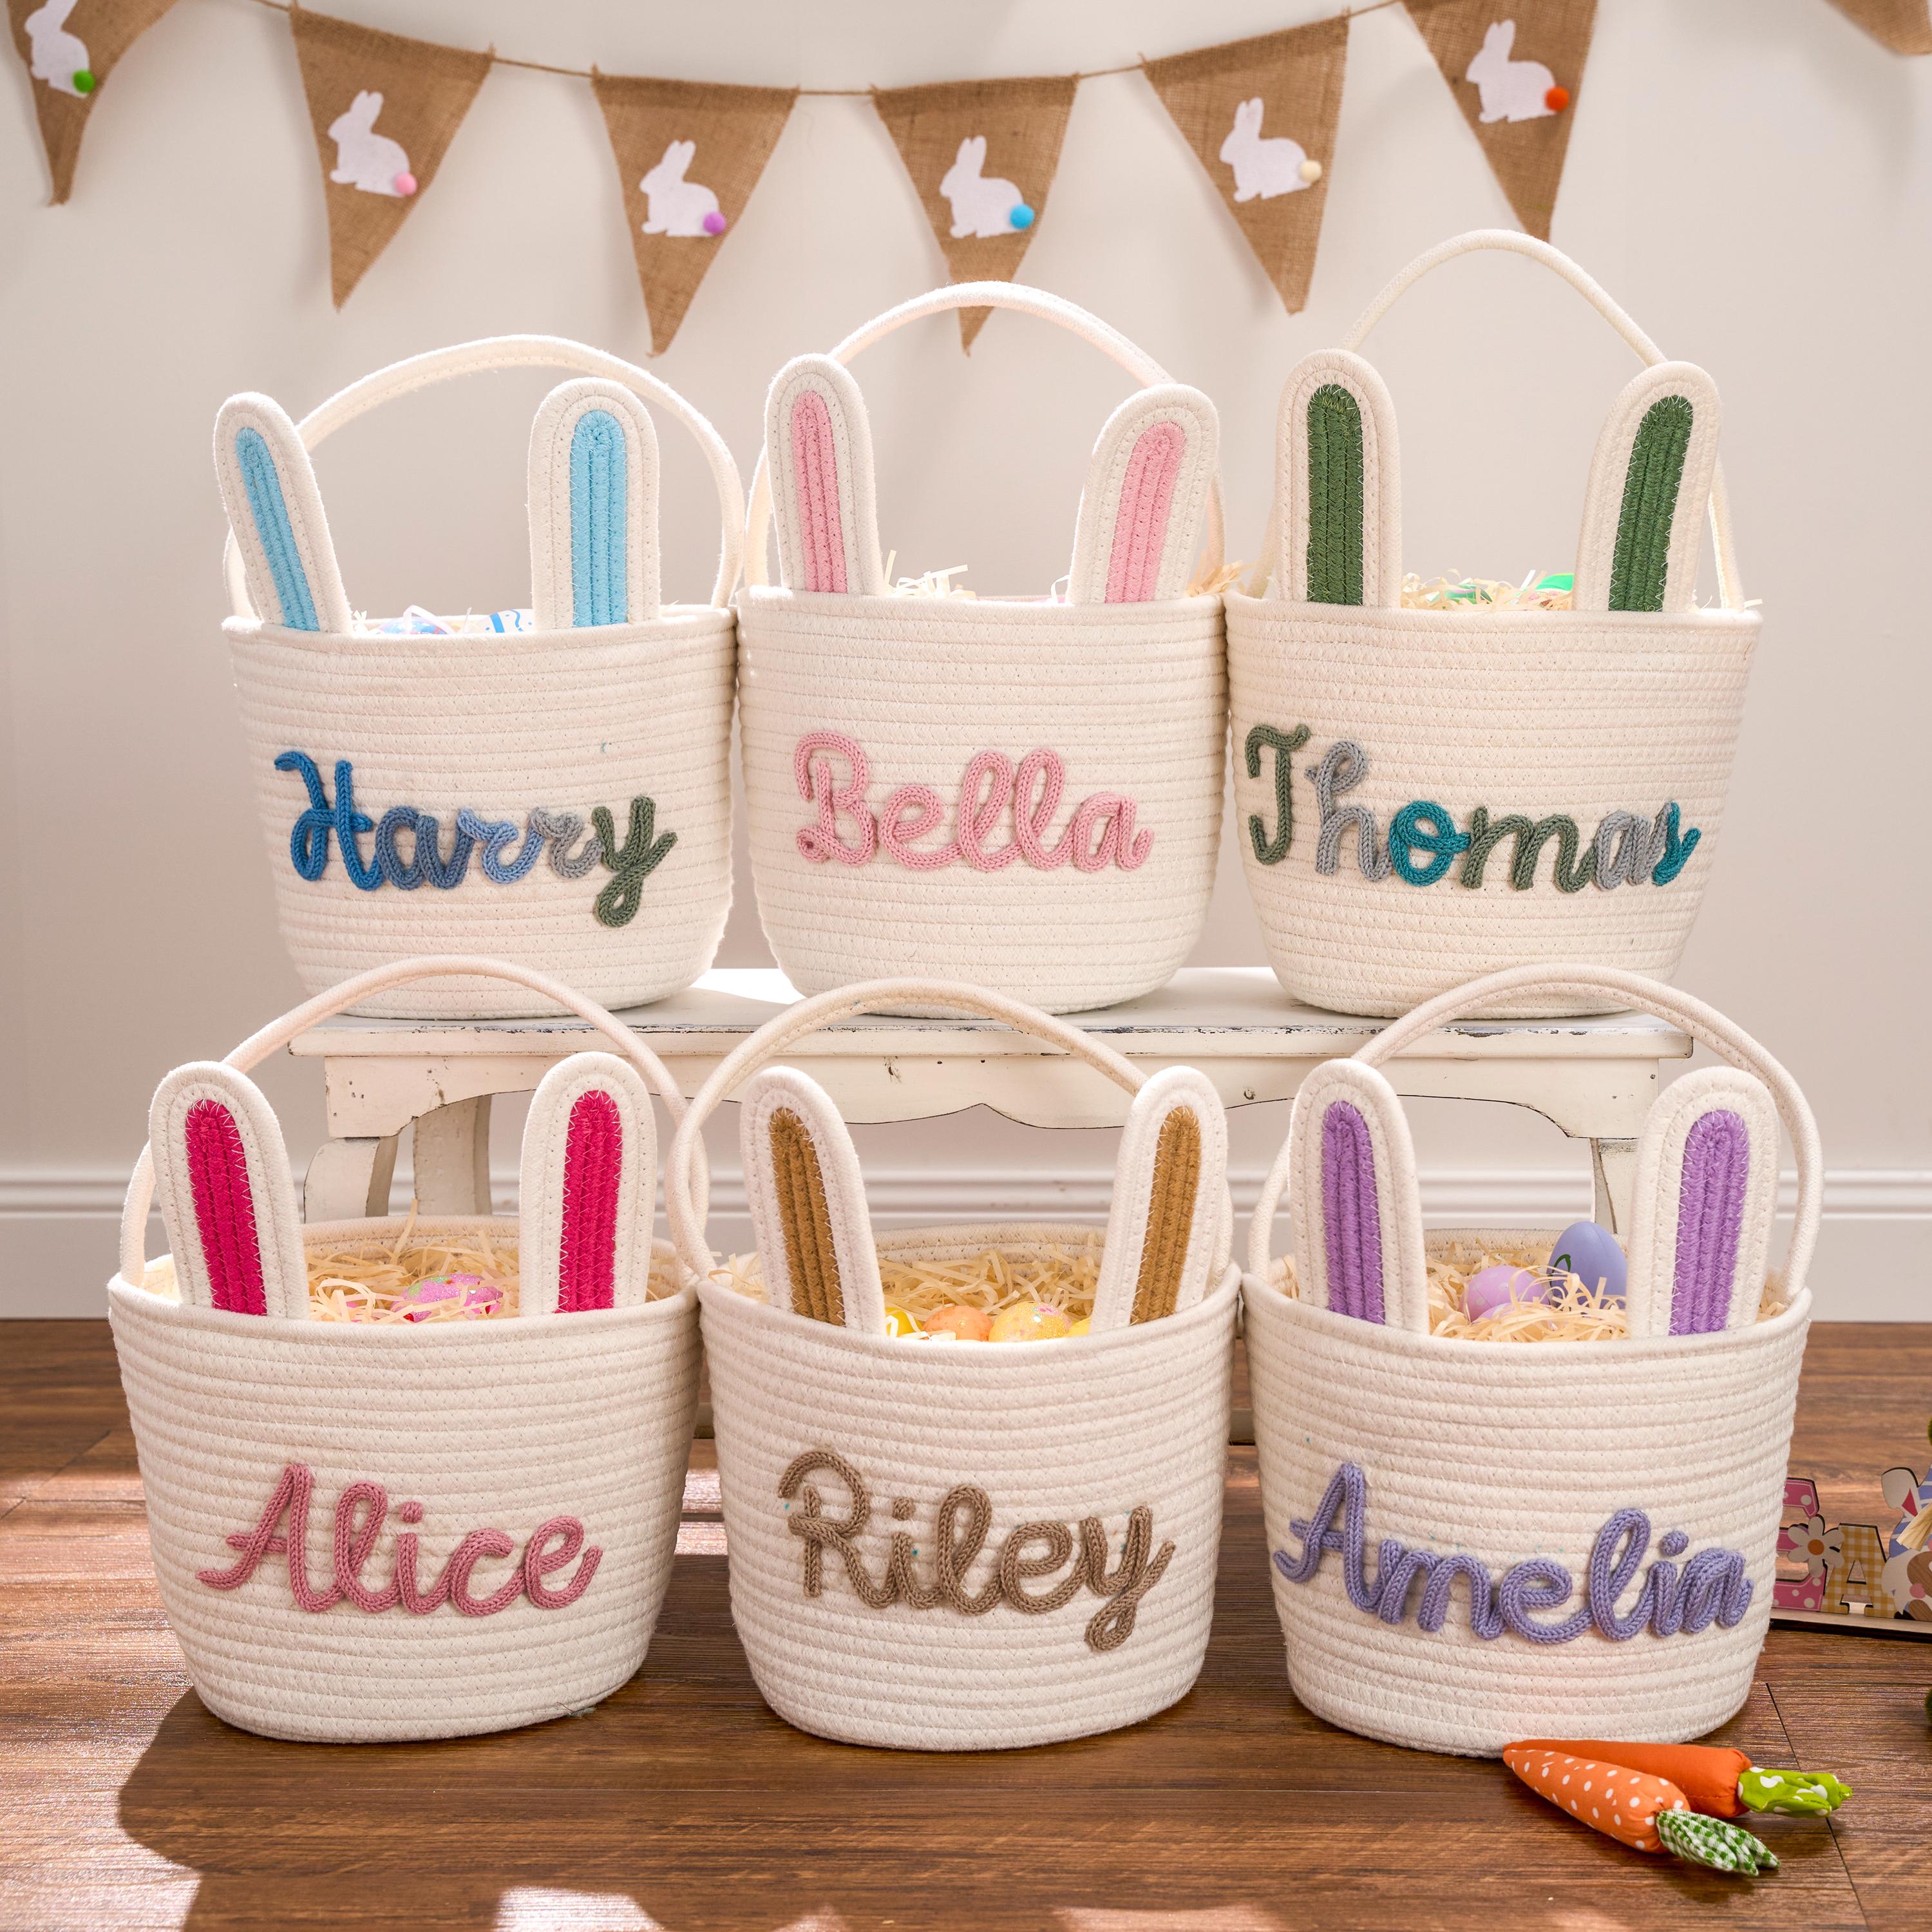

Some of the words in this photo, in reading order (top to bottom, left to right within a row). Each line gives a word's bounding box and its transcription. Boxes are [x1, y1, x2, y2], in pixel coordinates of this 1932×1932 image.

[274, 750, 678, 927] Harry
[794, 732, 1155, 873] Bella
[1244, 724, 1701, 893] Thomas
[195, 1463, 603, 1617] Alice
[777, 1451, 1176, 1651] Riley
[1273, 1463, 1754, 1644] Amelia
